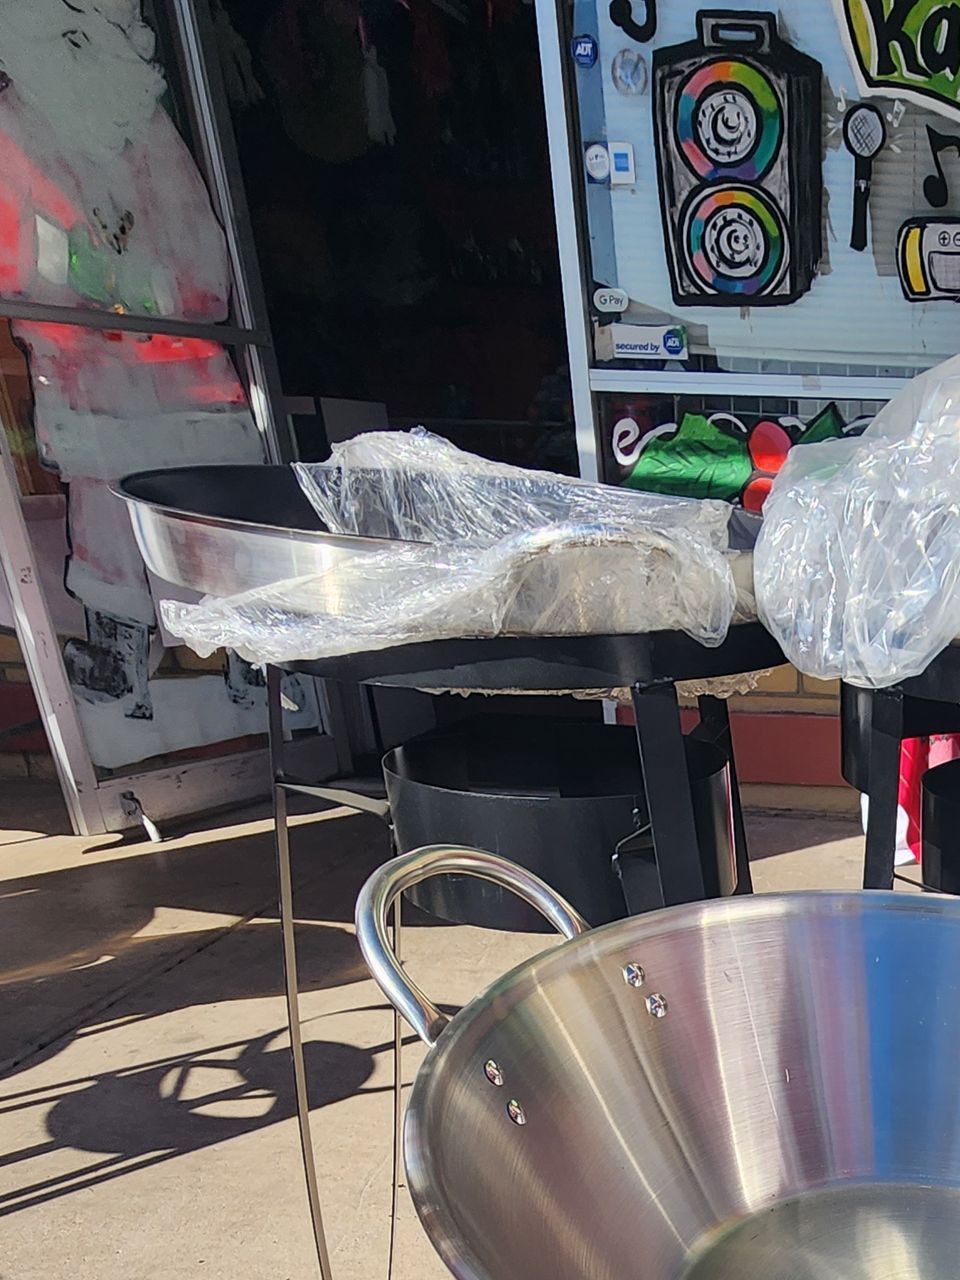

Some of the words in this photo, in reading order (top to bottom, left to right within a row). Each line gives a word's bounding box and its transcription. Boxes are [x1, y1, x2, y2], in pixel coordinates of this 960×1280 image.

[575, 43, 593, 56] ADT
[609, 295, 624, 305] Pay
[616, 342, 649, 351] secured
[650, 342, 660, 353] by
